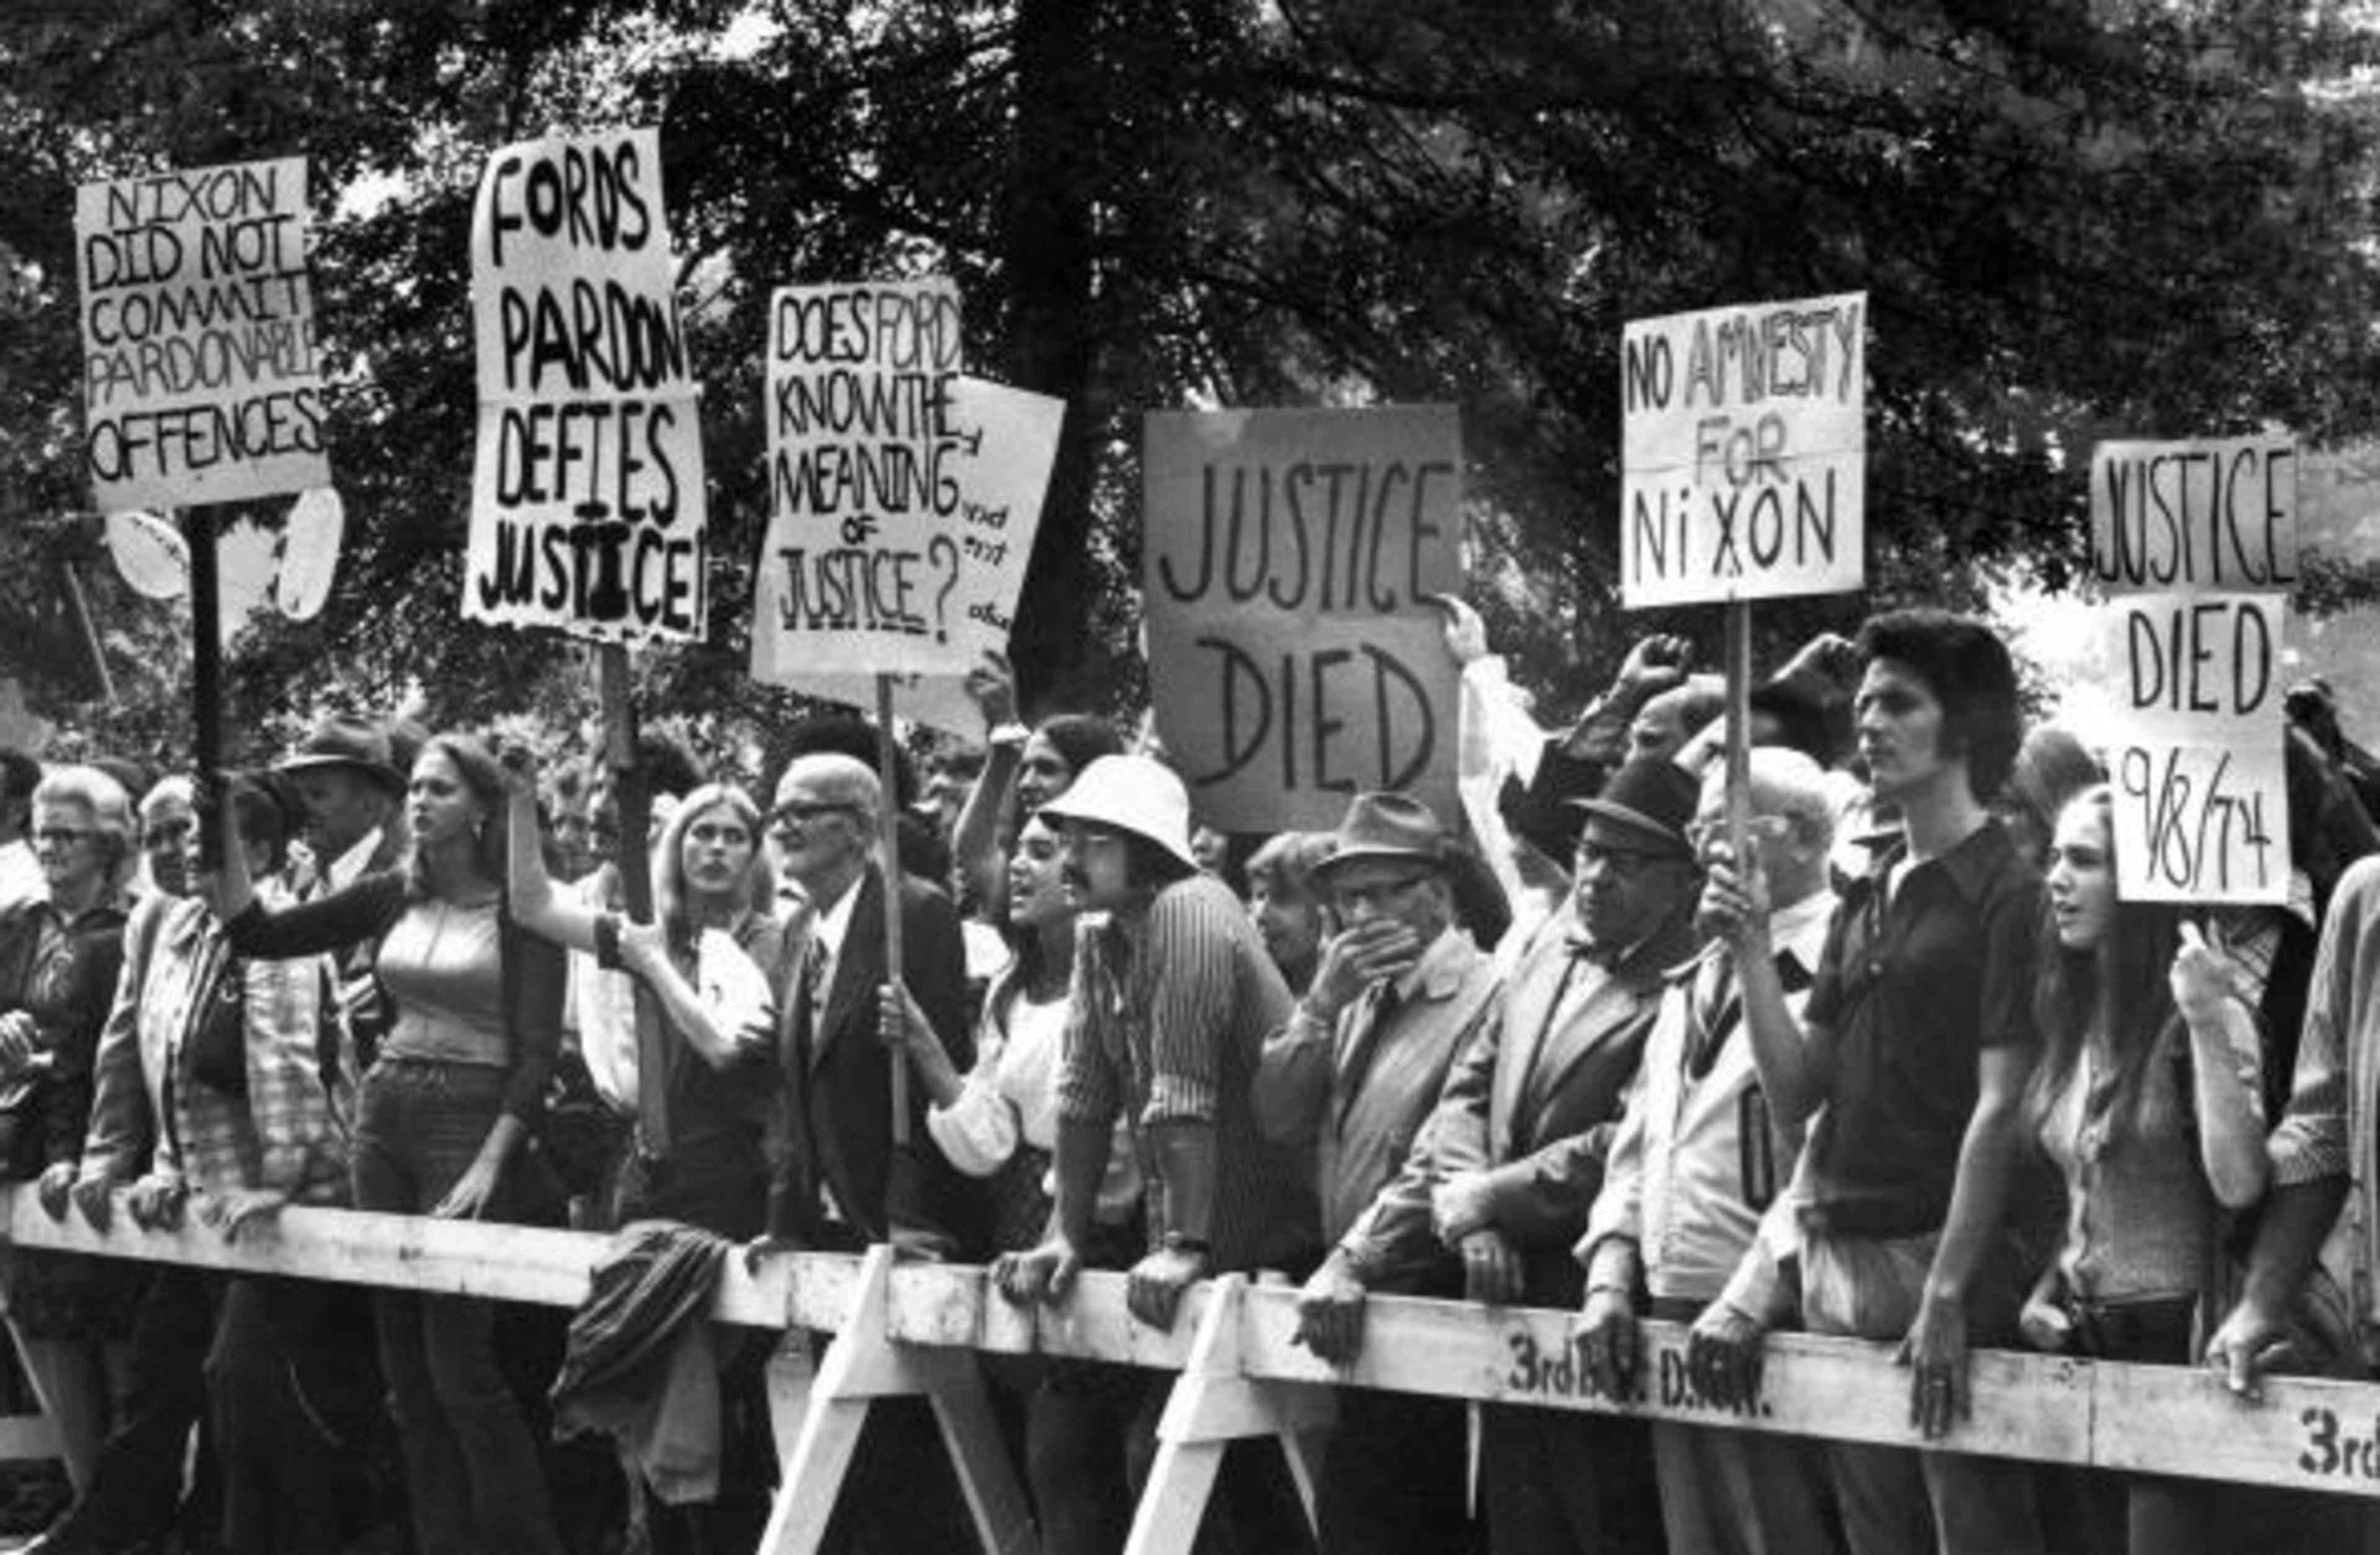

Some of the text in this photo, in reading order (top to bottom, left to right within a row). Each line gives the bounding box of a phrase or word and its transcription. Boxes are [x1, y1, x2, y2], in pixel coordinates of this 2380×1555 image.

[107, 166, 277, 227] NIXON
[491, 140, 651, 267] FORDS
[86, 213, 295, 291] DID NOT
[89, 269, 310, 345] COMMIT
[501, 277, 683, 392] PARDON
[778, 289, 961, 369] DOES FORD
[775, 370, 961, 440] KNOW THE
[1627, 302, 1860, 414] NO AMNESTY
[90, 387, 325, 482] OFFENCES
[496, 400, 679, 527] DEFIES
[772, 441, 959, 517] MEANING
[1695, 412, 1791, 488] FOR
[840, 514, 880, 545] OF
[1158, 460, 1455, 612] JUSTICE
[2095, 447, 2296, 586] JUSTICE
[2128, 602, 2272, 716] DIED
[1194, 635, 1435, 792] DIED
[2121, 746, 2272, 893] 9/8/74
[1509, 1332, 1576, 1396] 3rd
